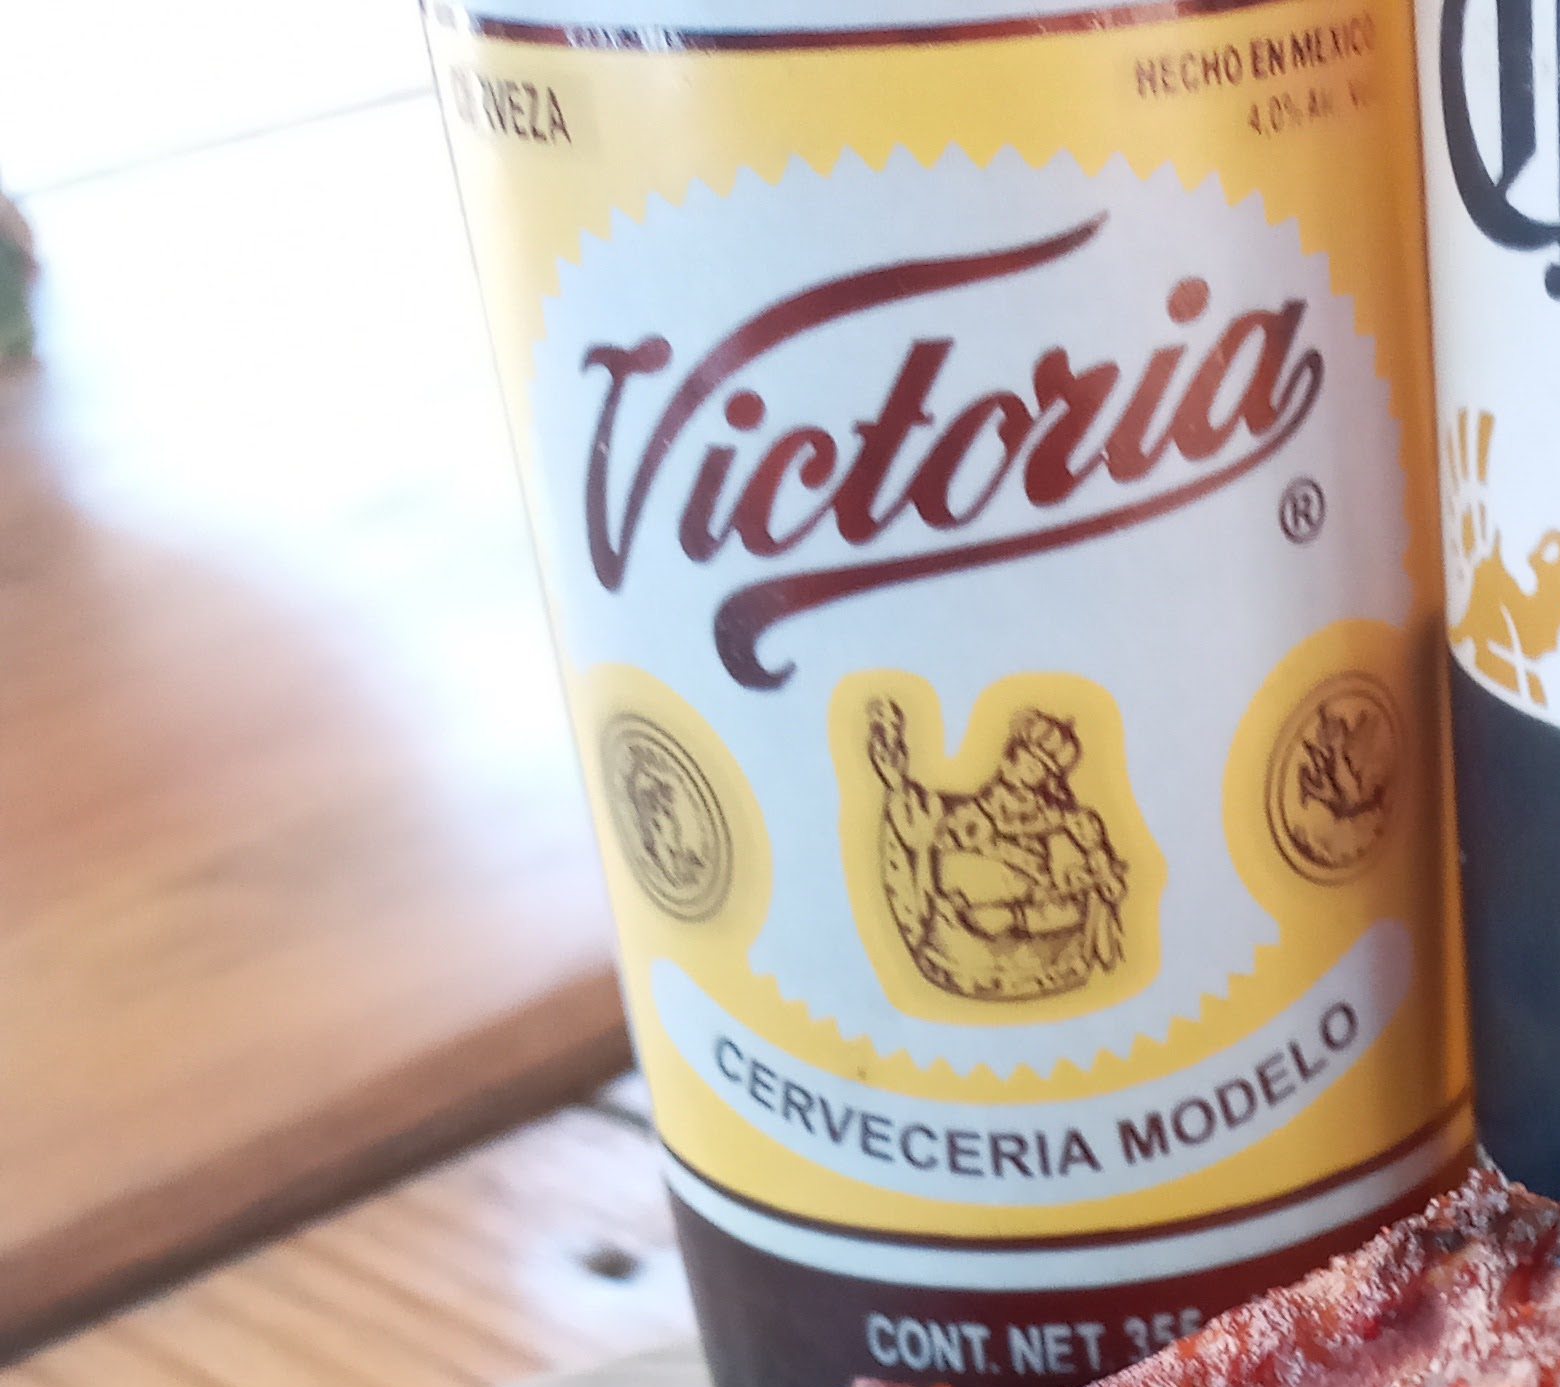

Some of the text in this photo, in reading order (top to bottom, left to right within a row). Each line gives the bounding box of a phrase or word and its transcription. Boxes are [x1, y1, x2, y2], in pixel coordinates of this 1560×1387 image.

[1136, 44, 1243, 98] HECHO
[1250, 37, 1286, 80] EN
[582, 210, 1326, 692] Victoria
[713, 1000, 1360, 1180] CERVECERIA MODELO
[865, 1312, 1001, 1375] CONT.
[1006, 1321, 1106, 1376] NET
